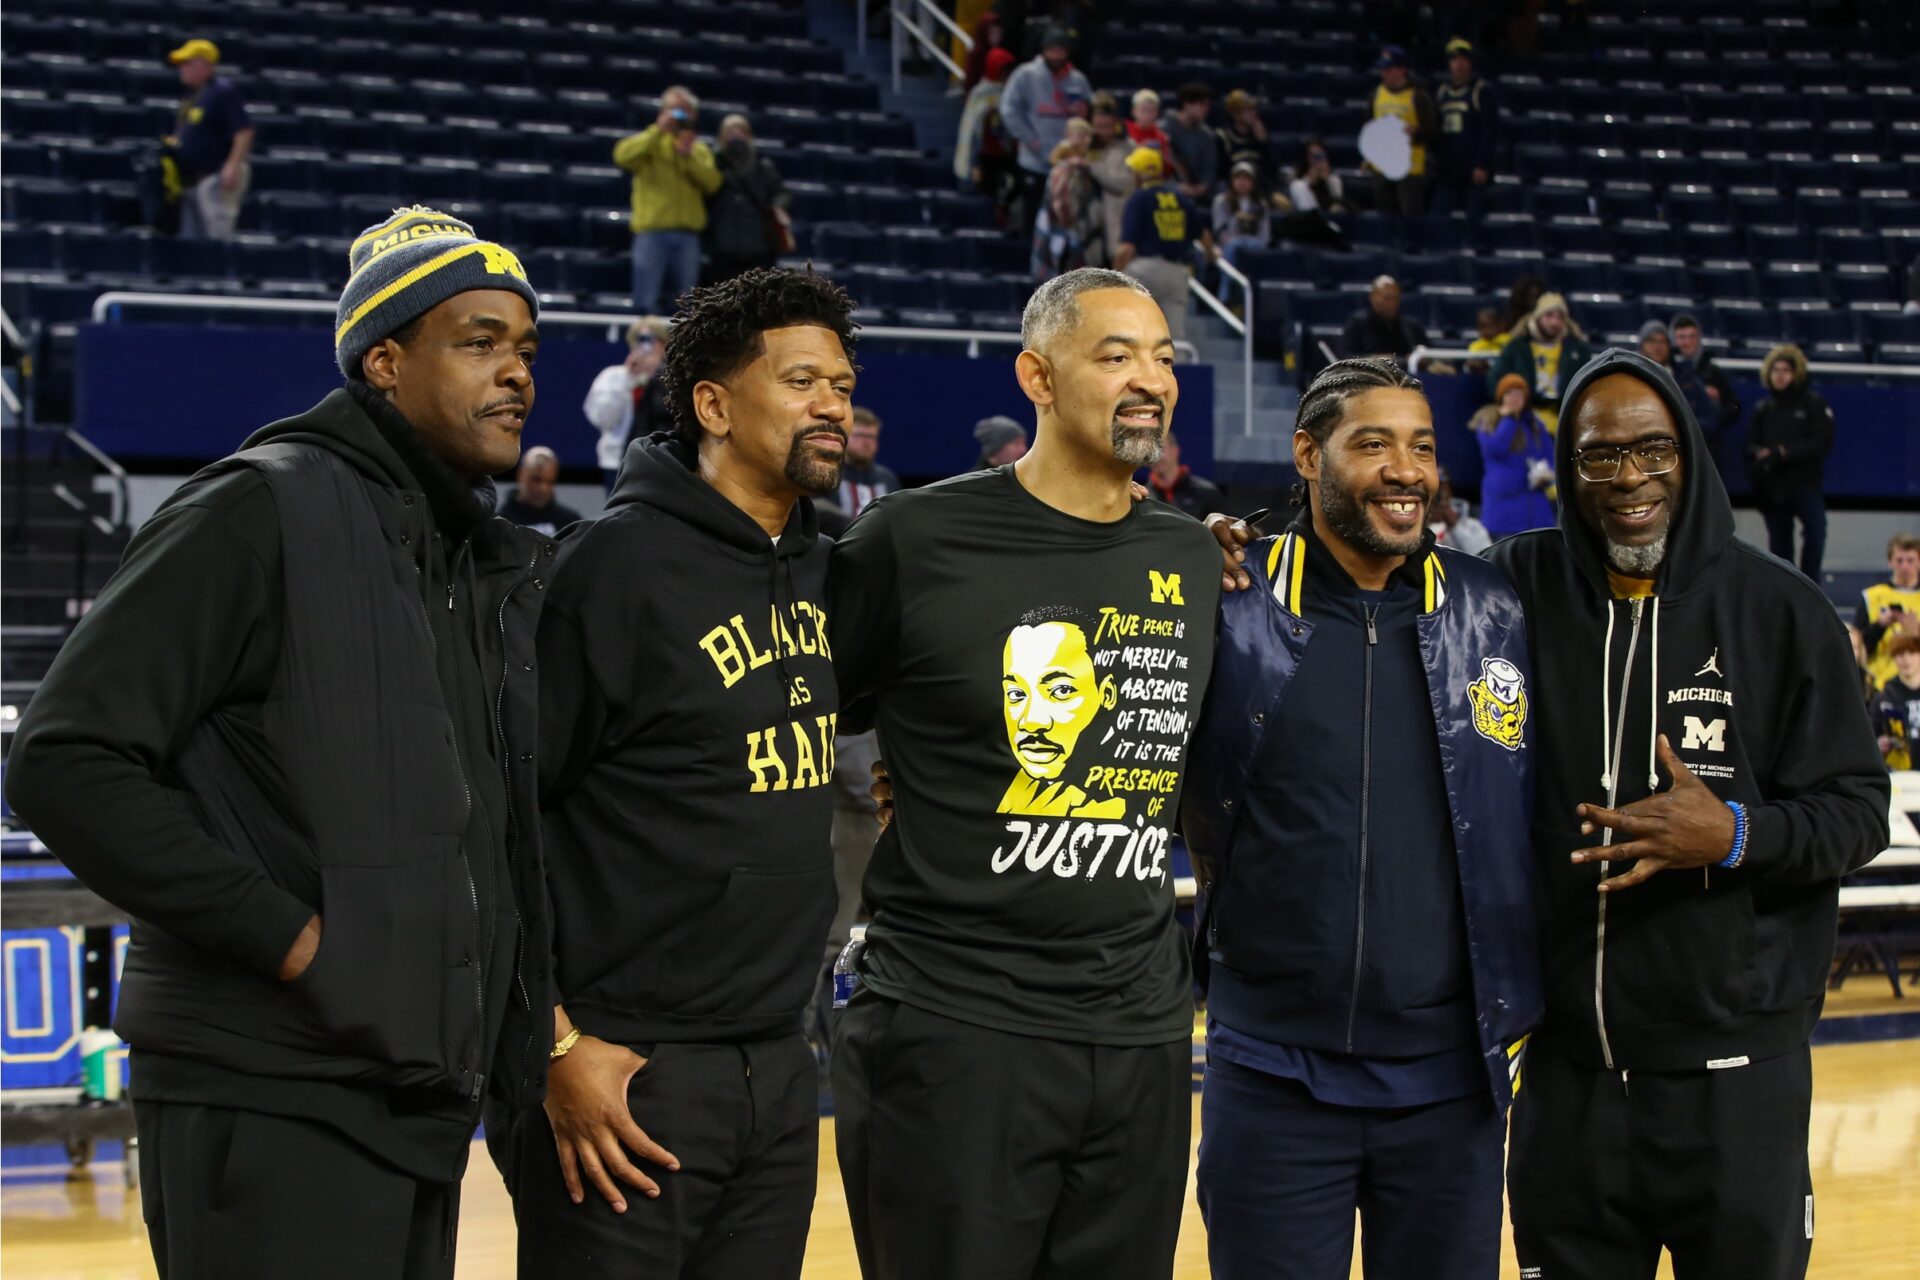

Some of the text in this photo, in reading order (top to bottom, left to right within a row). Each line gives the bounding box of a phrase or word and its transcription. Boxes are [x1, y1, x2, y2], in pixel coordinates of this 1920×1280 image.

[1148, 569, 1185, 606] M
[1093, 606, 1140, 646] TRUE
[1142, 618, 1174, 637] PEACE
[698, 600, 833, 689] BLACK
[1093, 645, 1189, 675] NOT MERELY THE
[788, 675, 812, 707] AS
[1120, 677, 1189, 704] ABSENCE
[1492, 677, 1511, 701] M
[1666, 686, 1734, 707] MICHIGA
[1116, 709, 1136, 731] OF
[1681, 715, 1727, 752] M
[746, 711, 837, 793] HAI
[1153, 743, 1182, 762] THE
[1083, 765, 1179, 798] PRESENCE
[1699, 769, 1734, 778] BASKETBALL
[1707, 764, 1735, 773] MICHIGAN
[1146, 796, 1166, 818] OF
